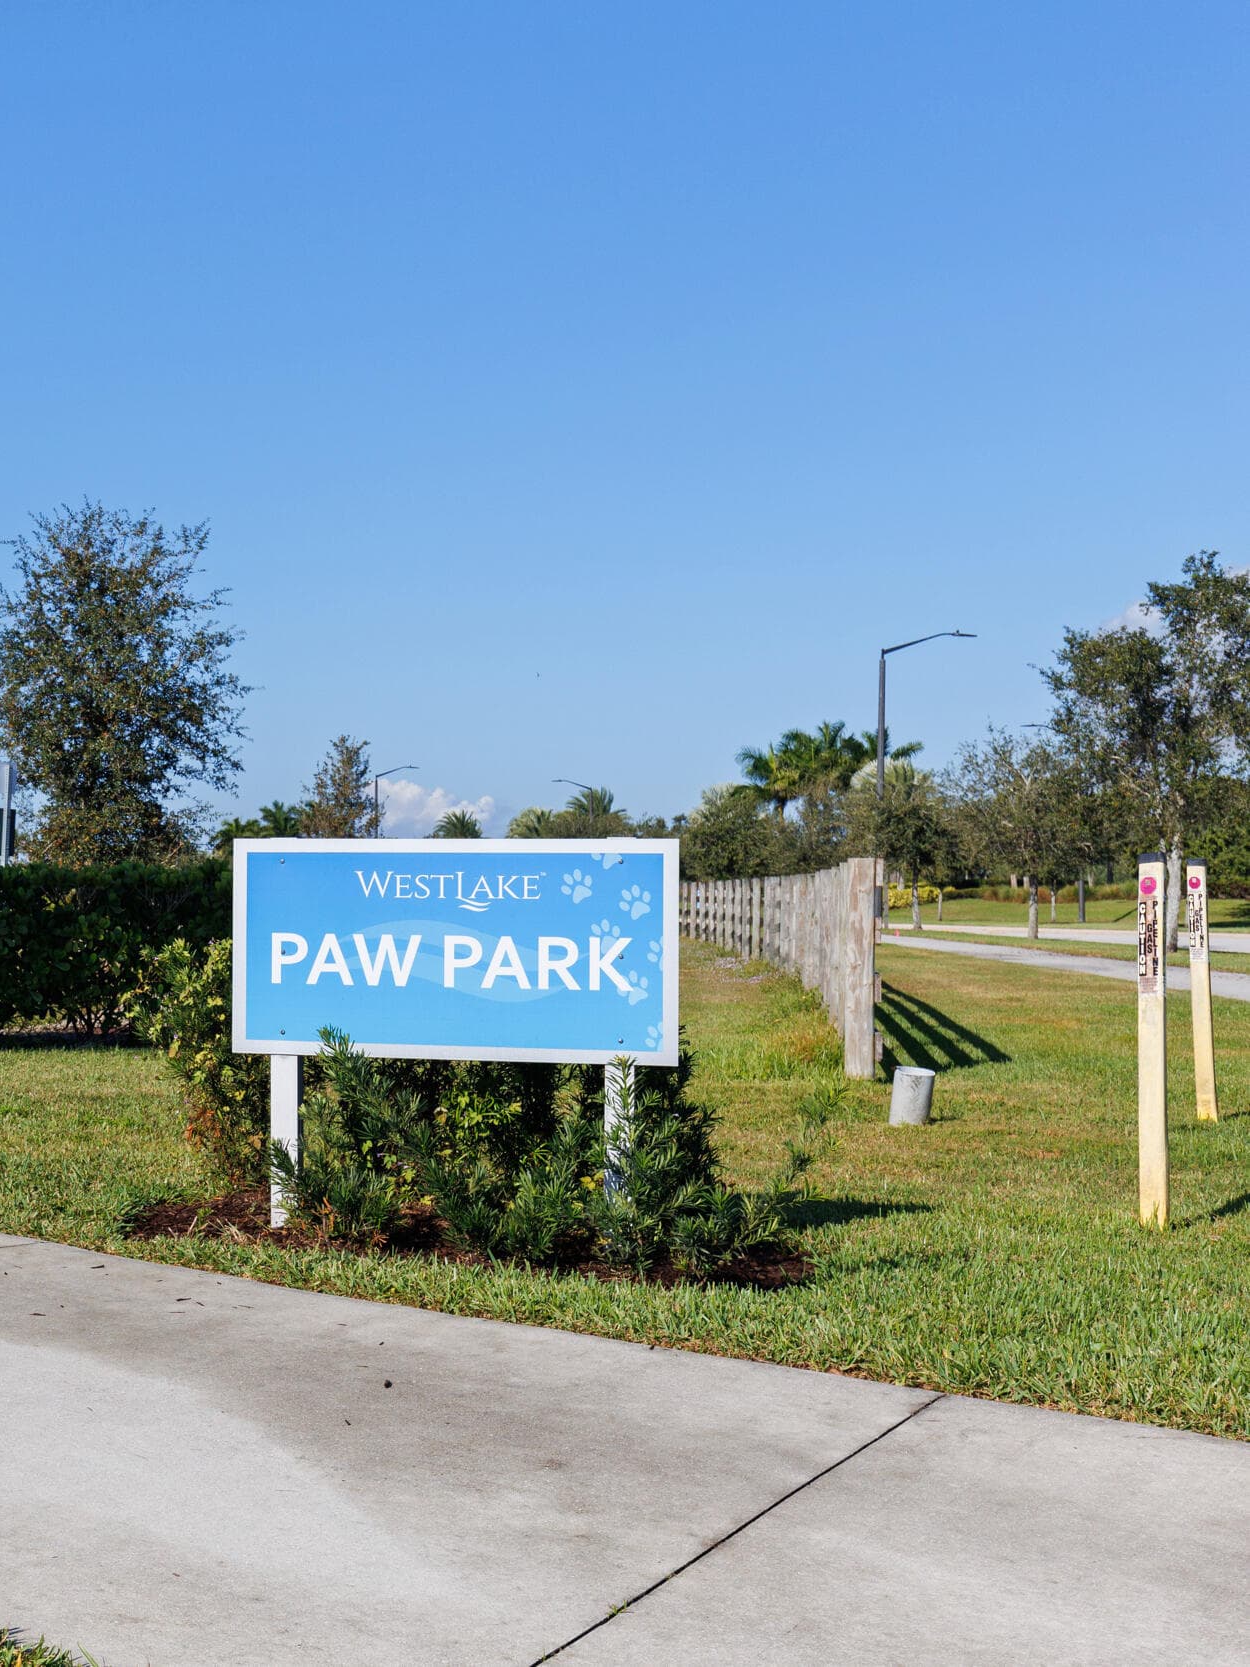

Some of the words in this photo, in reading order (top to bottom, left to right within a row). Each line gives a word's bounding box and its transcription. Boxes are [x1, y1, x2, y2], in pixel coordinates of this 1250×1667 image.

[355, 870, 542, 908] WESTLAKE
[271, 931, 422, 987] PAW
[443, 934, 634, 992] PARK
